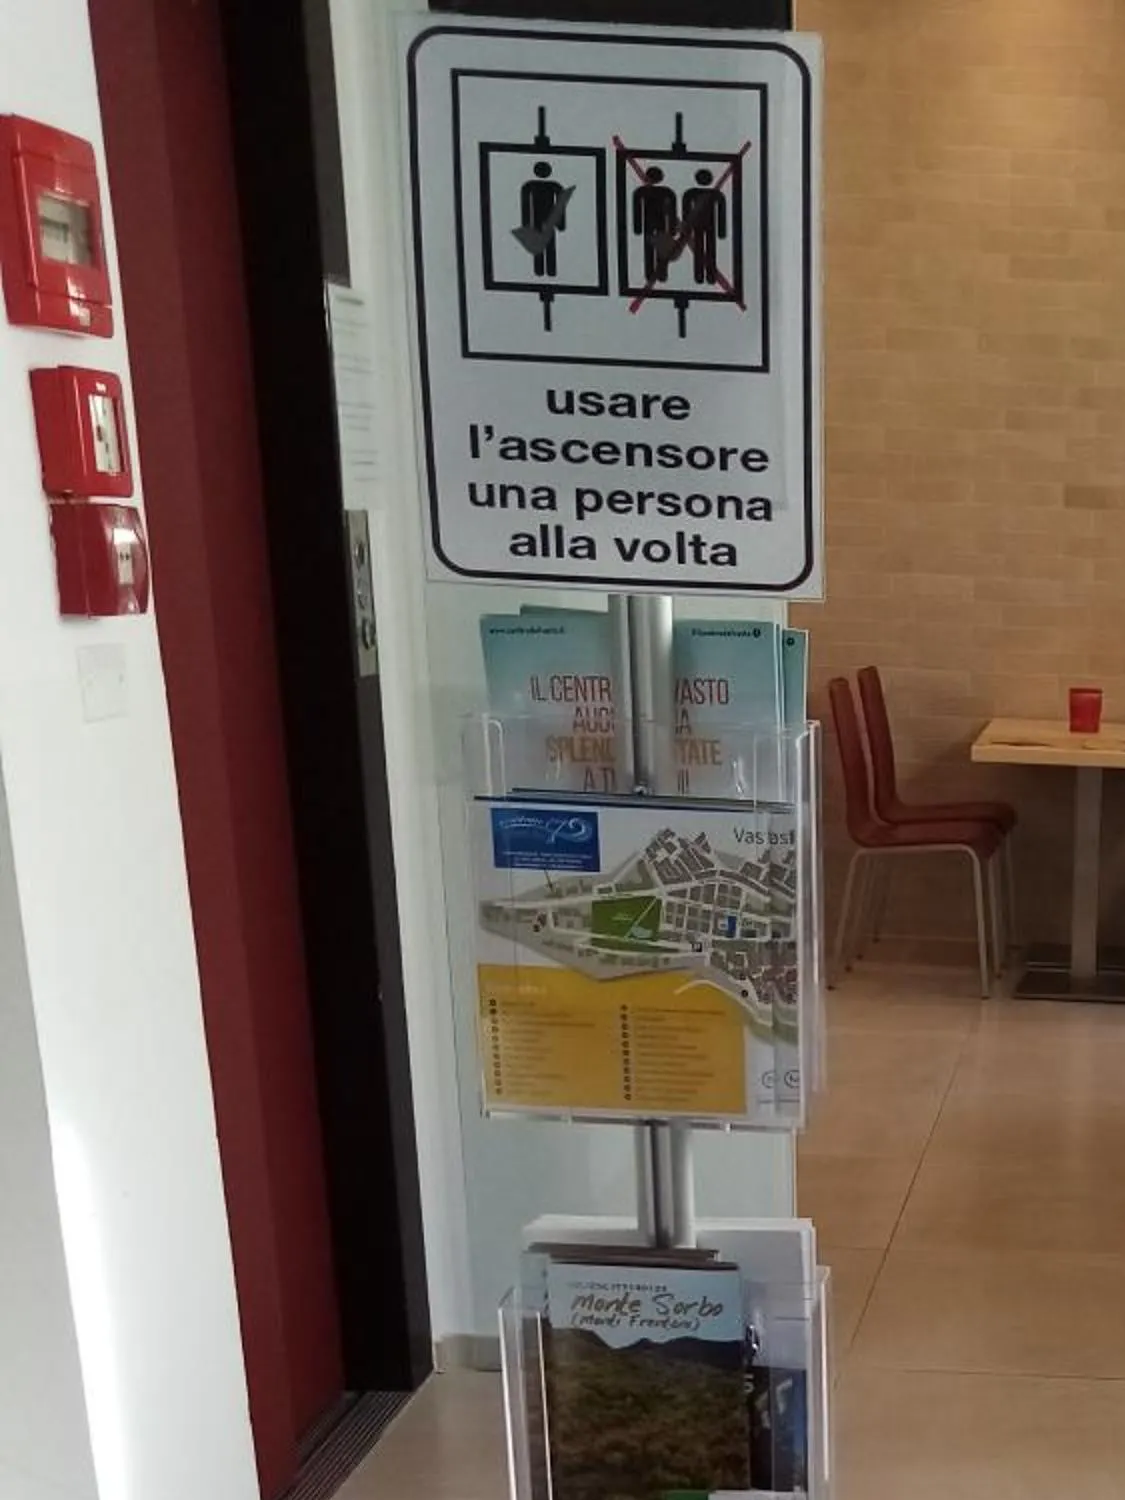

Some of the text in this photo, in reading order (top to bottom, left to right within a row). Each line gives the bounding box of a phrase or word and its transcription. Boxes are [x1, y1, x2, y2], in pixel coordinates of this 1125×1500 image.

[546, 389, 691, 420] usare
[469, 424, 769, 473] l’ascensore
[468, 482, 773, 521] una persona
[509, 524, 737, 566] alla volta
[550, 675, 612, 702] CENTR
